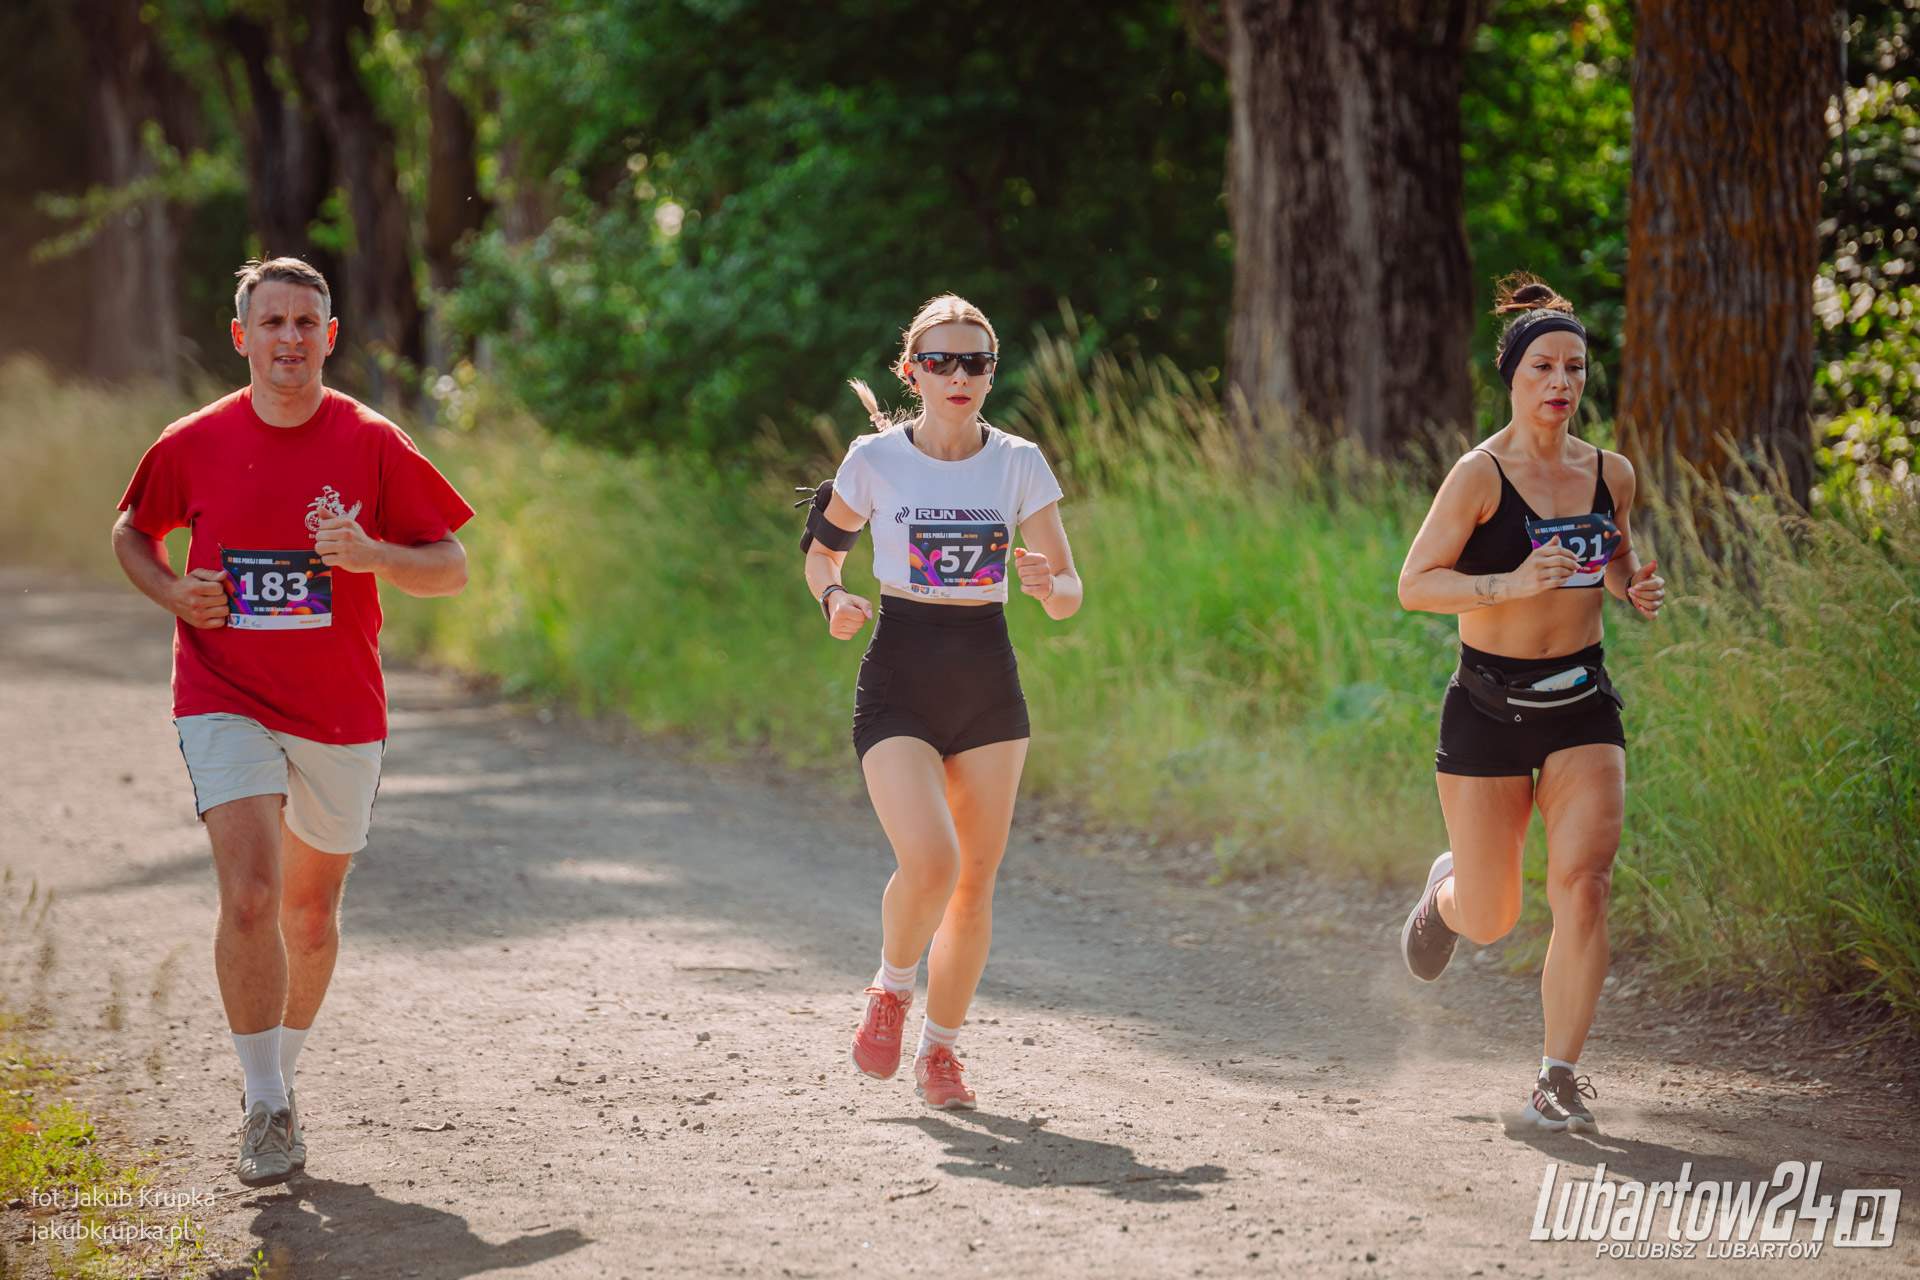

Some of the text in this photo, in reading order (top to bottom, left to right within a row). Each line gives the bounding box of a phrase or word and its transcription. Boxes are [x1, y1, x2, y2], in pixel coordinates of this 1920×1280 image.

[918, 509, 956, 519] RUN
[940, 546, 983, 573] 57
[240, 571, 308, 601] 183
